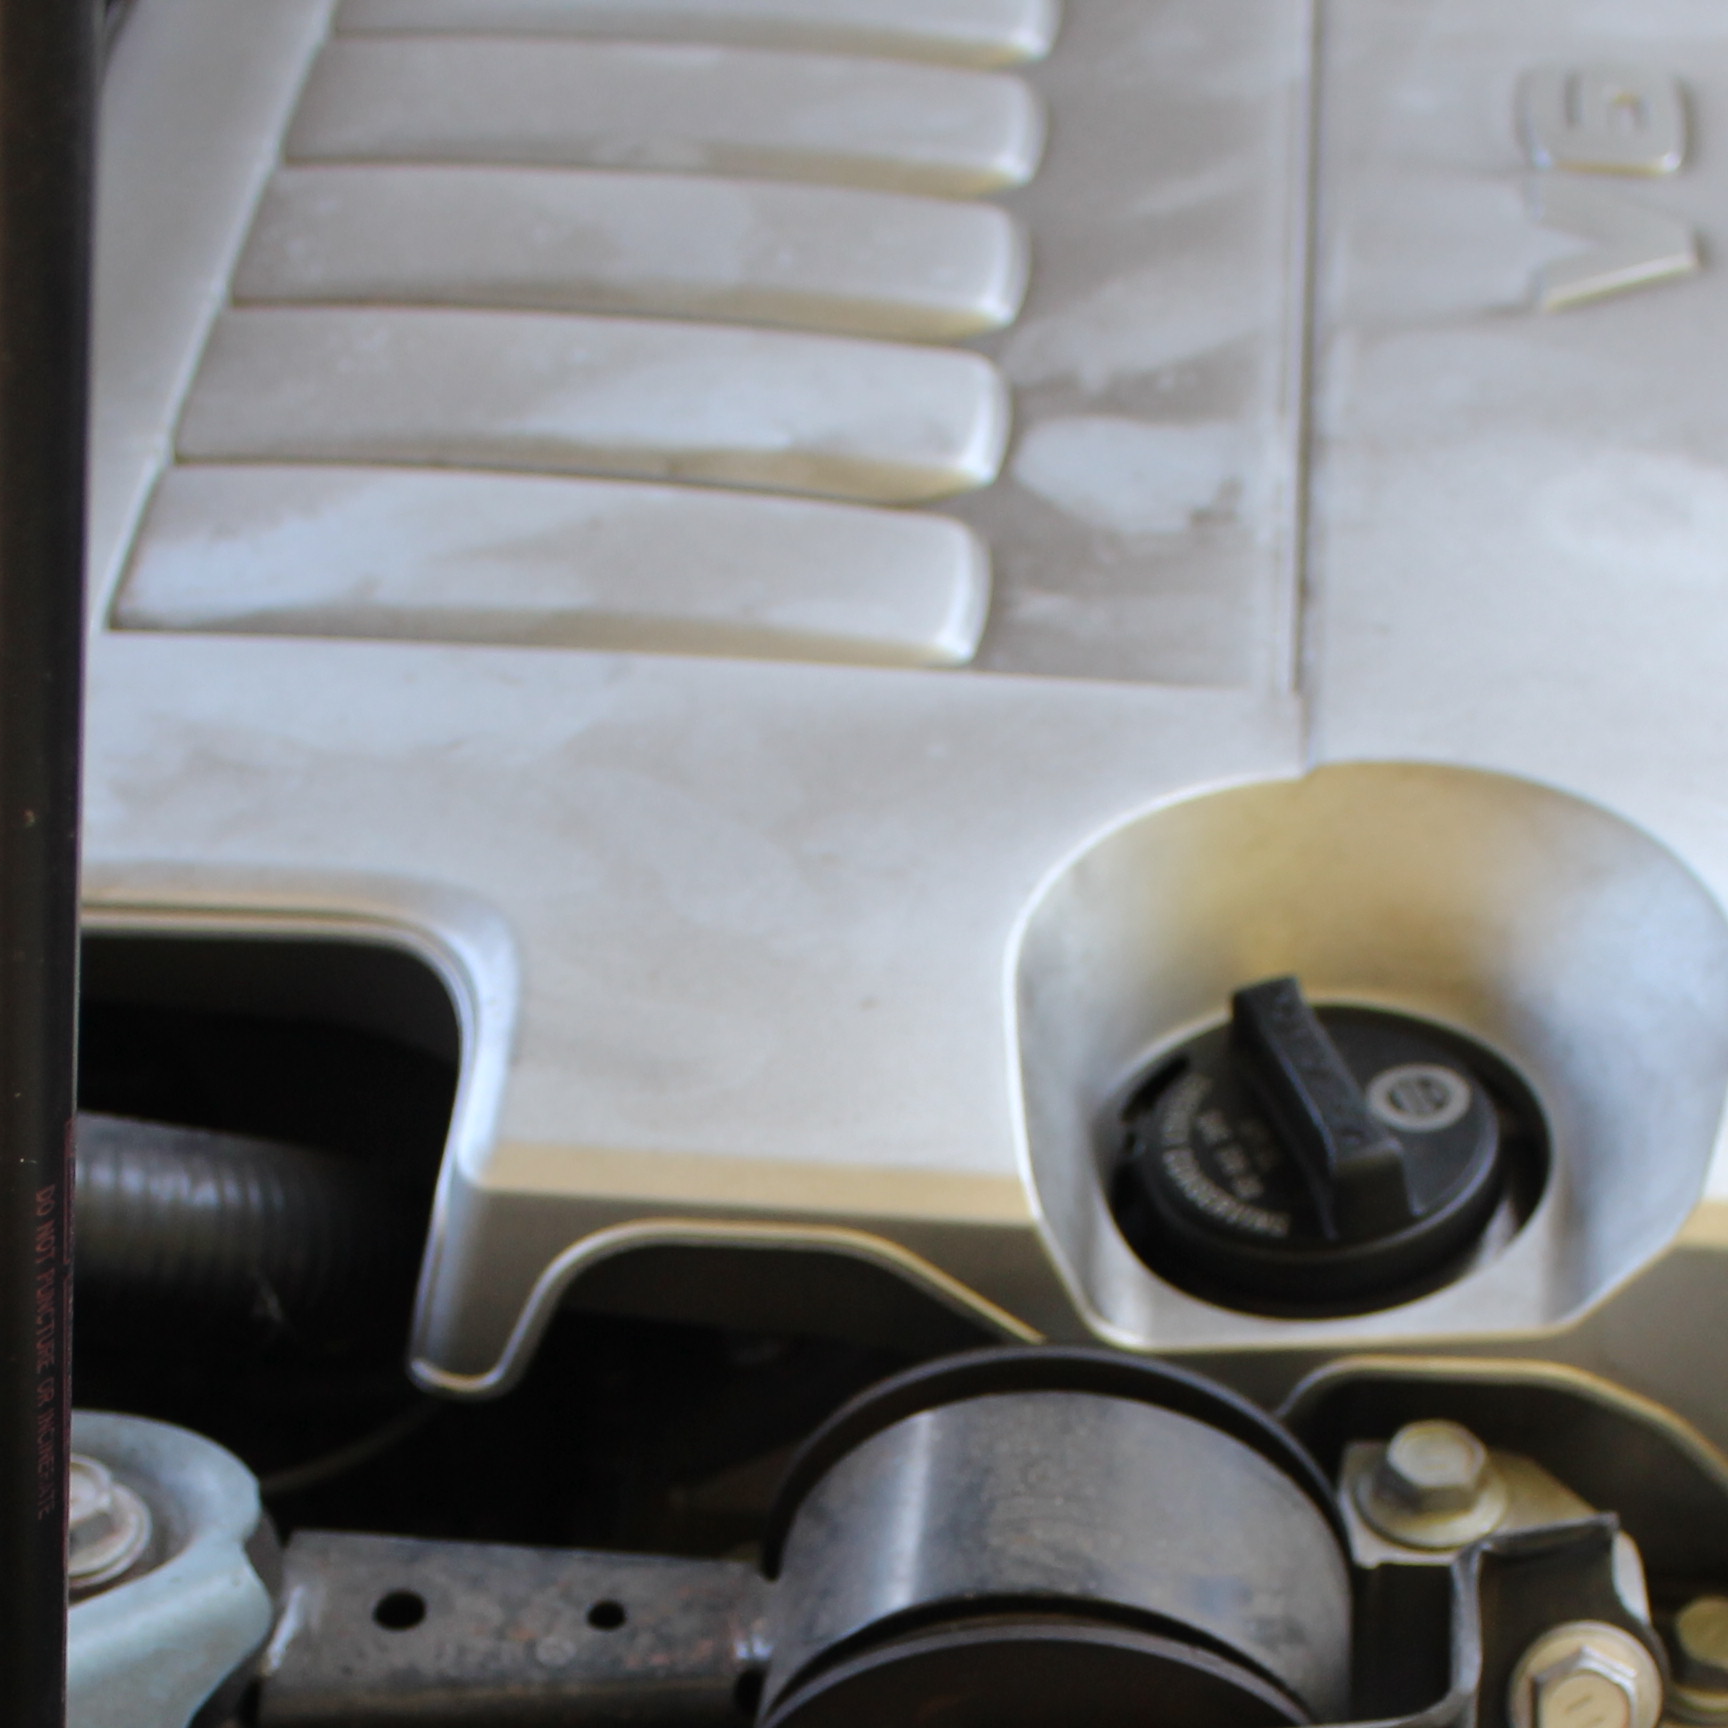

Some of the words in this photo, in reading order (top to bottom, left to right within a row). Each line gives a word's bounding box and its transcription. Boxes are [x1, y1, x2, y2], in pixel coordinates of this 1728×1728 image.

[1518, 67, 1697, 309] V6
[35, 1185, 55, 1217] DO
[34, 1221, 55, 1265] NOT
[35, 1269, 55, 1374] PUNCTURE
